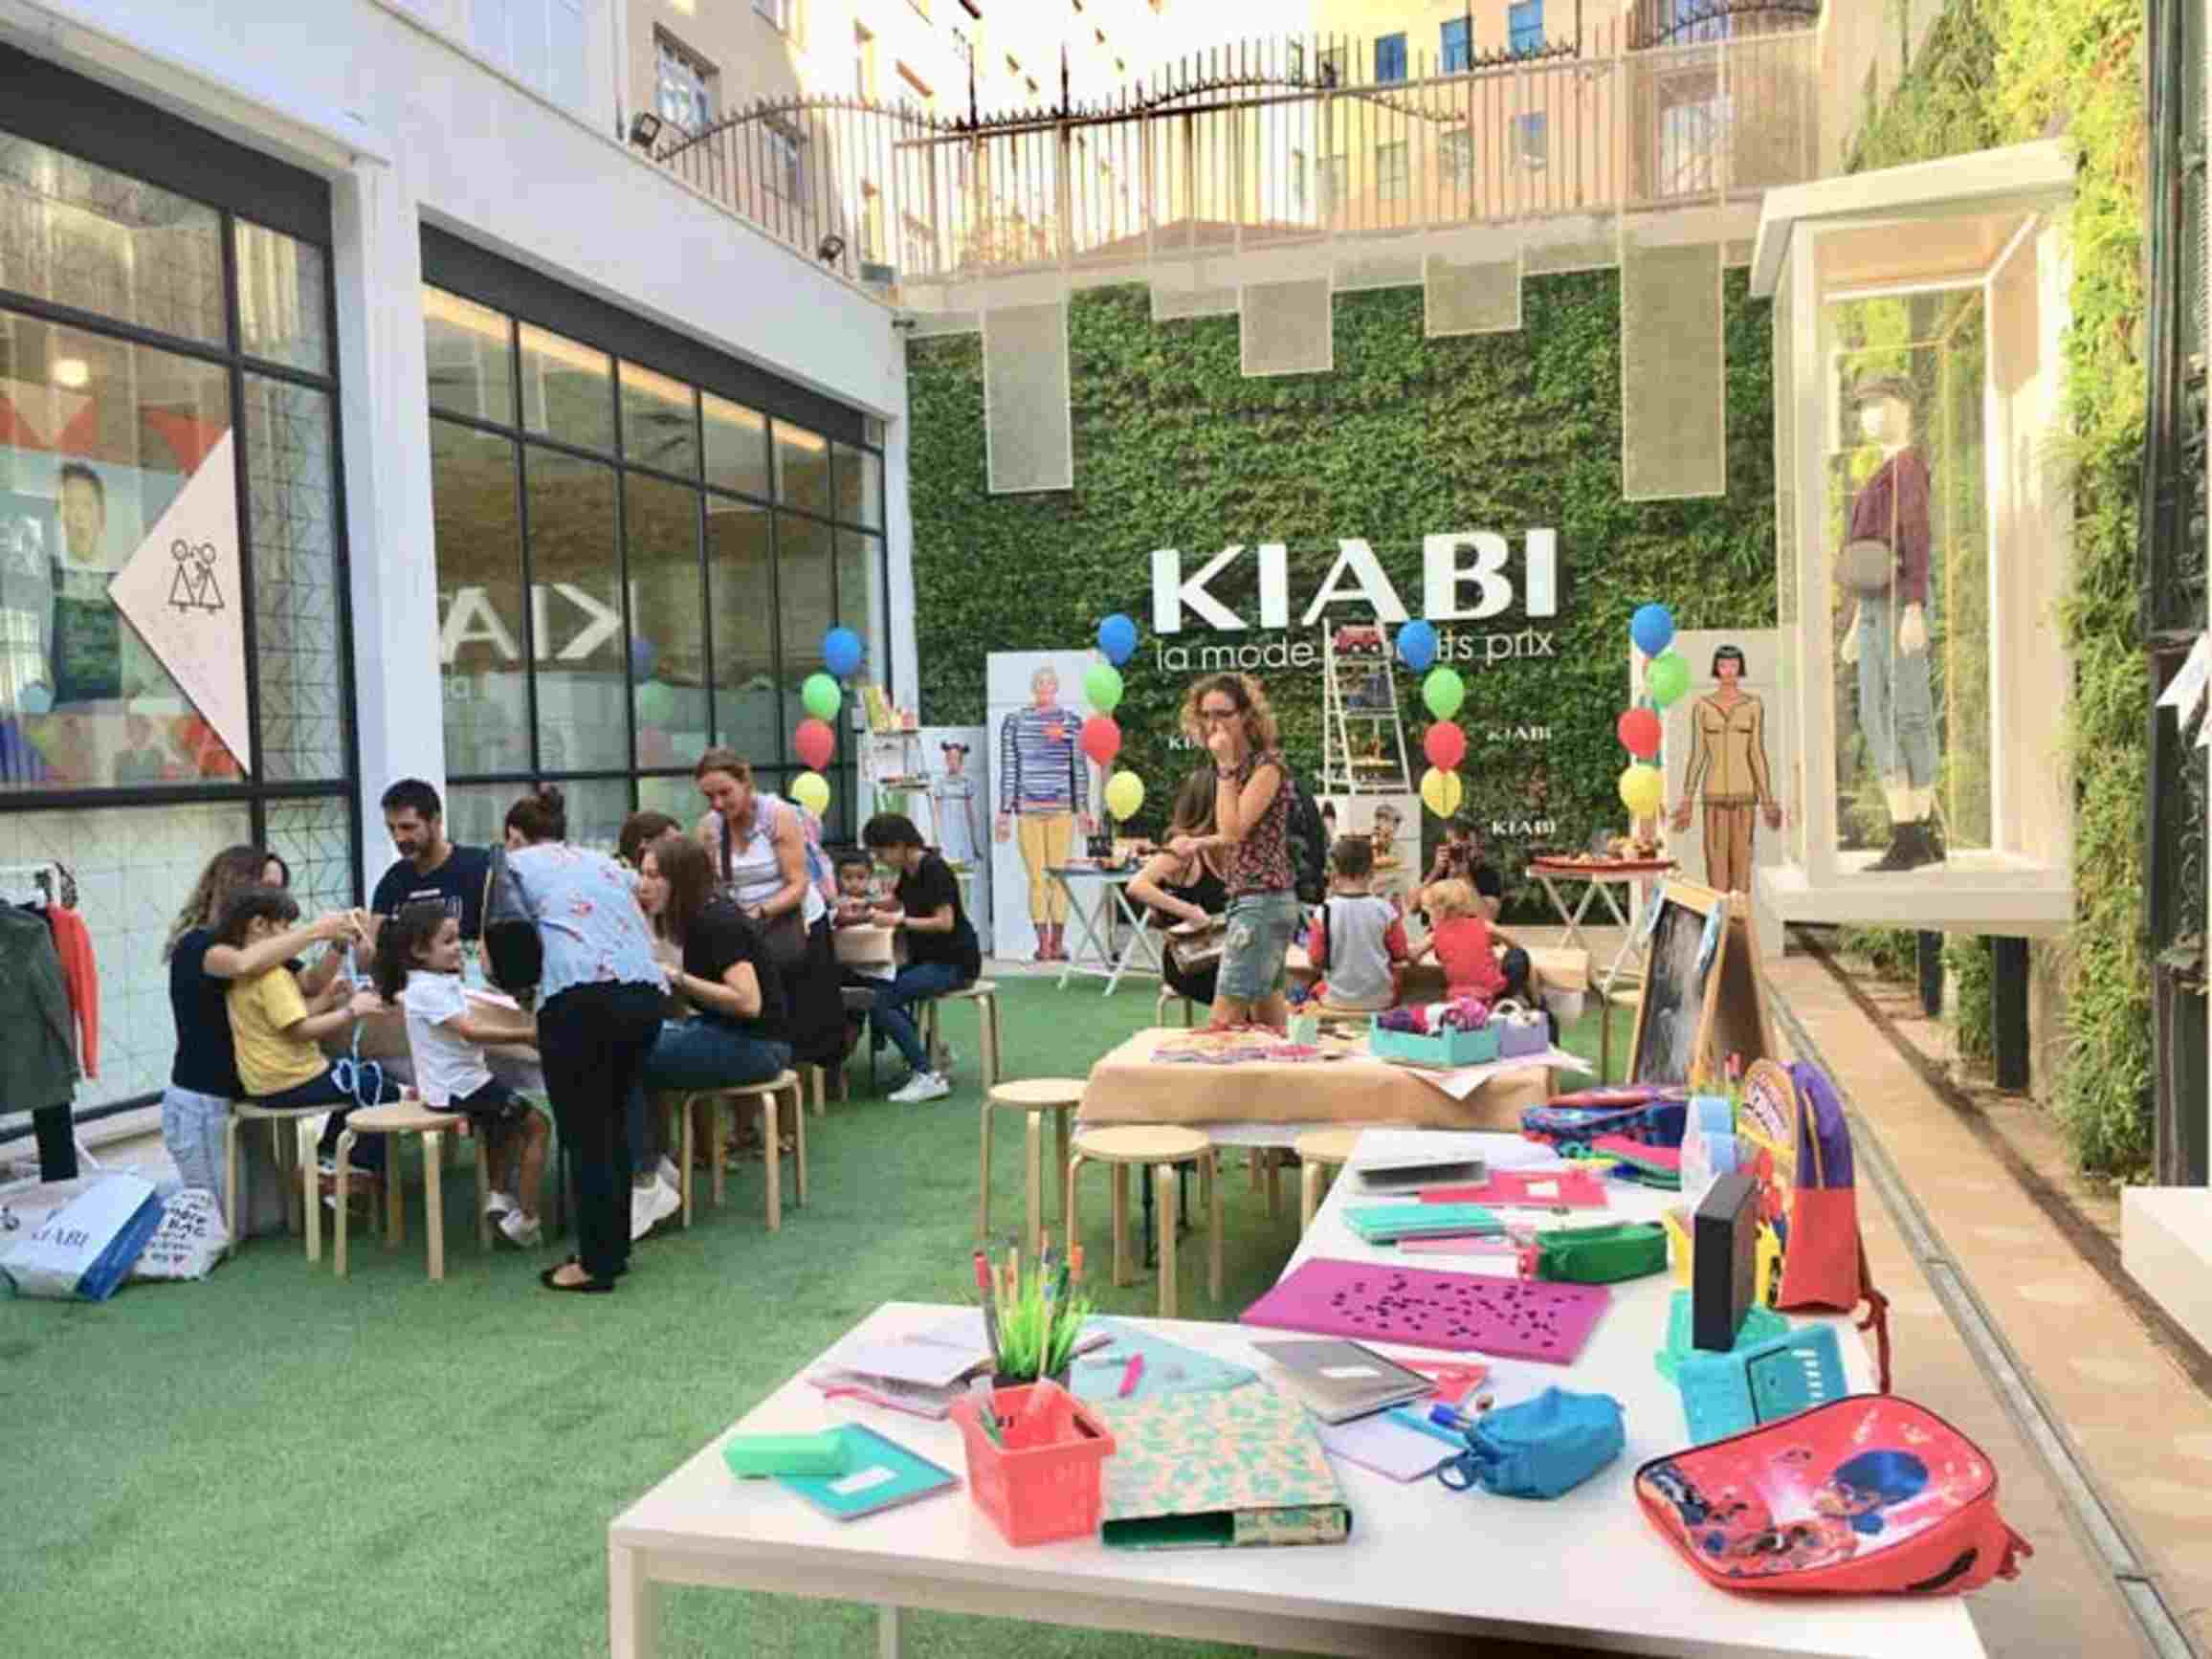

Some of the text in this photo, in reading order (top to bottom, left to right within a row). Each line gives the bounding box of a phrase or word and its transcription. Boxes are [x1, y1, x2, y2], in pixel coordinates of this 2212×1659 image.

[1152, 527, 1557, 633] KIABI
[1157, 639, 1188, 671] la
[1202, 635, 1315, 670] mode
[1484, 628, 1554, 667] prix
[1493, 820, 1557, 835] KIABI
